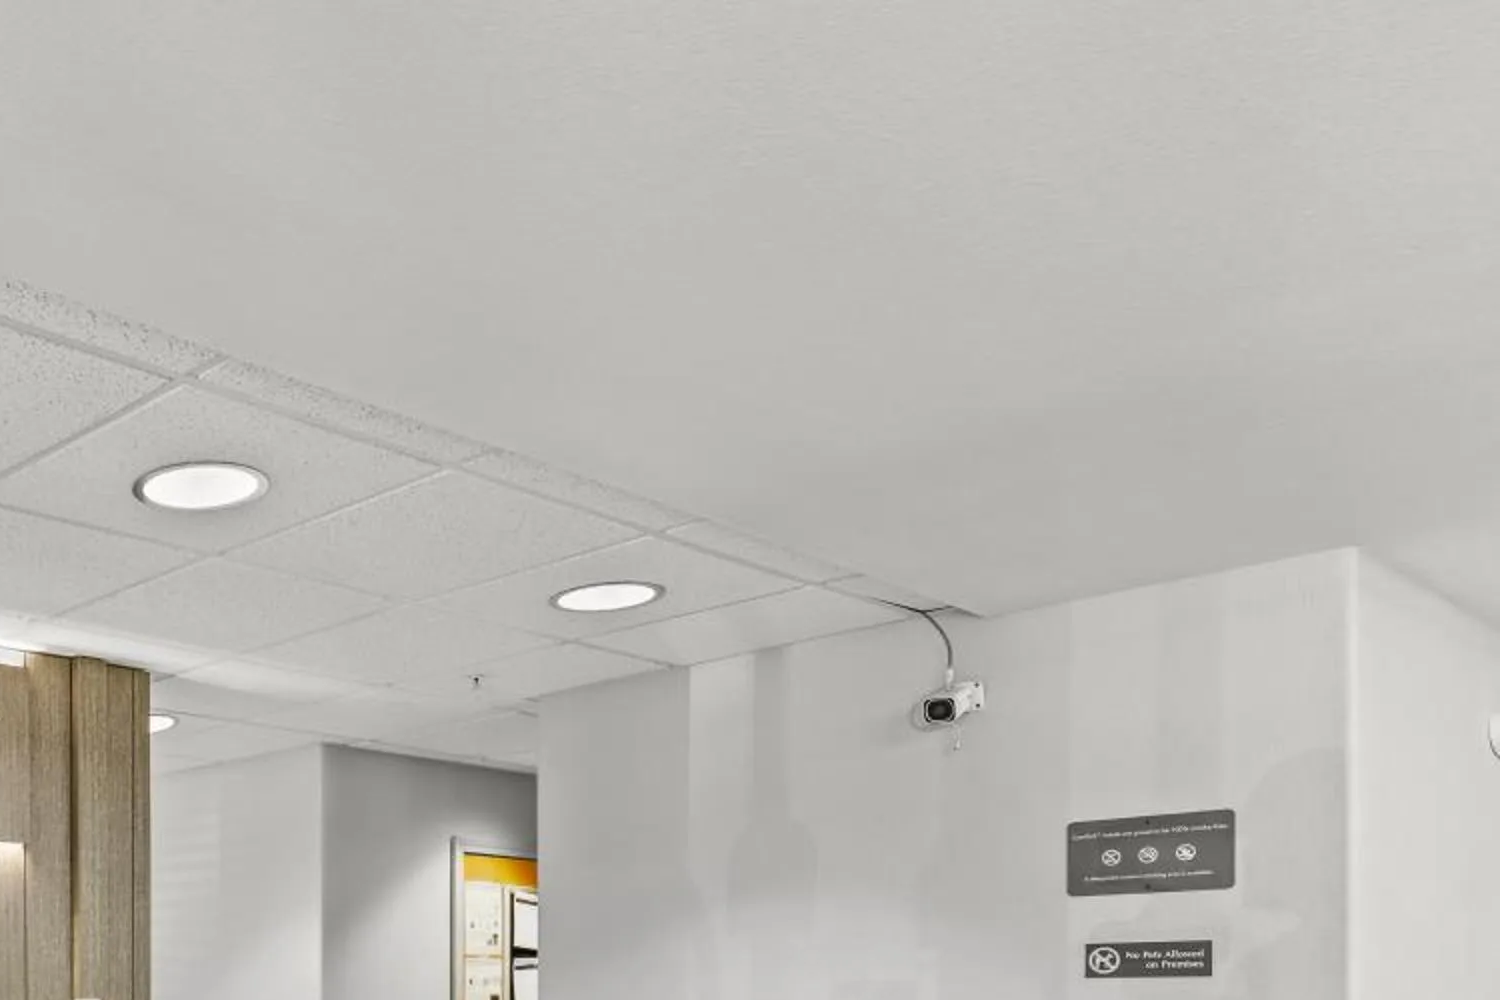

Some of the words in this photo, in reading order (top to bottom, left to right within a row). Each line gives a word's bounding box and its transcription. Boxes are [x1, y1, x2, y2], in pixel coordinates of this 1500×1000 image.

[1125, 951, 1141, 959] No
[1143, 950, 1162, 959] Pets
[1165, 948, 1205, 958] Allowed
[1145, 961, 1159, 969] on
[1161, 959, 1205, 969] Premises
